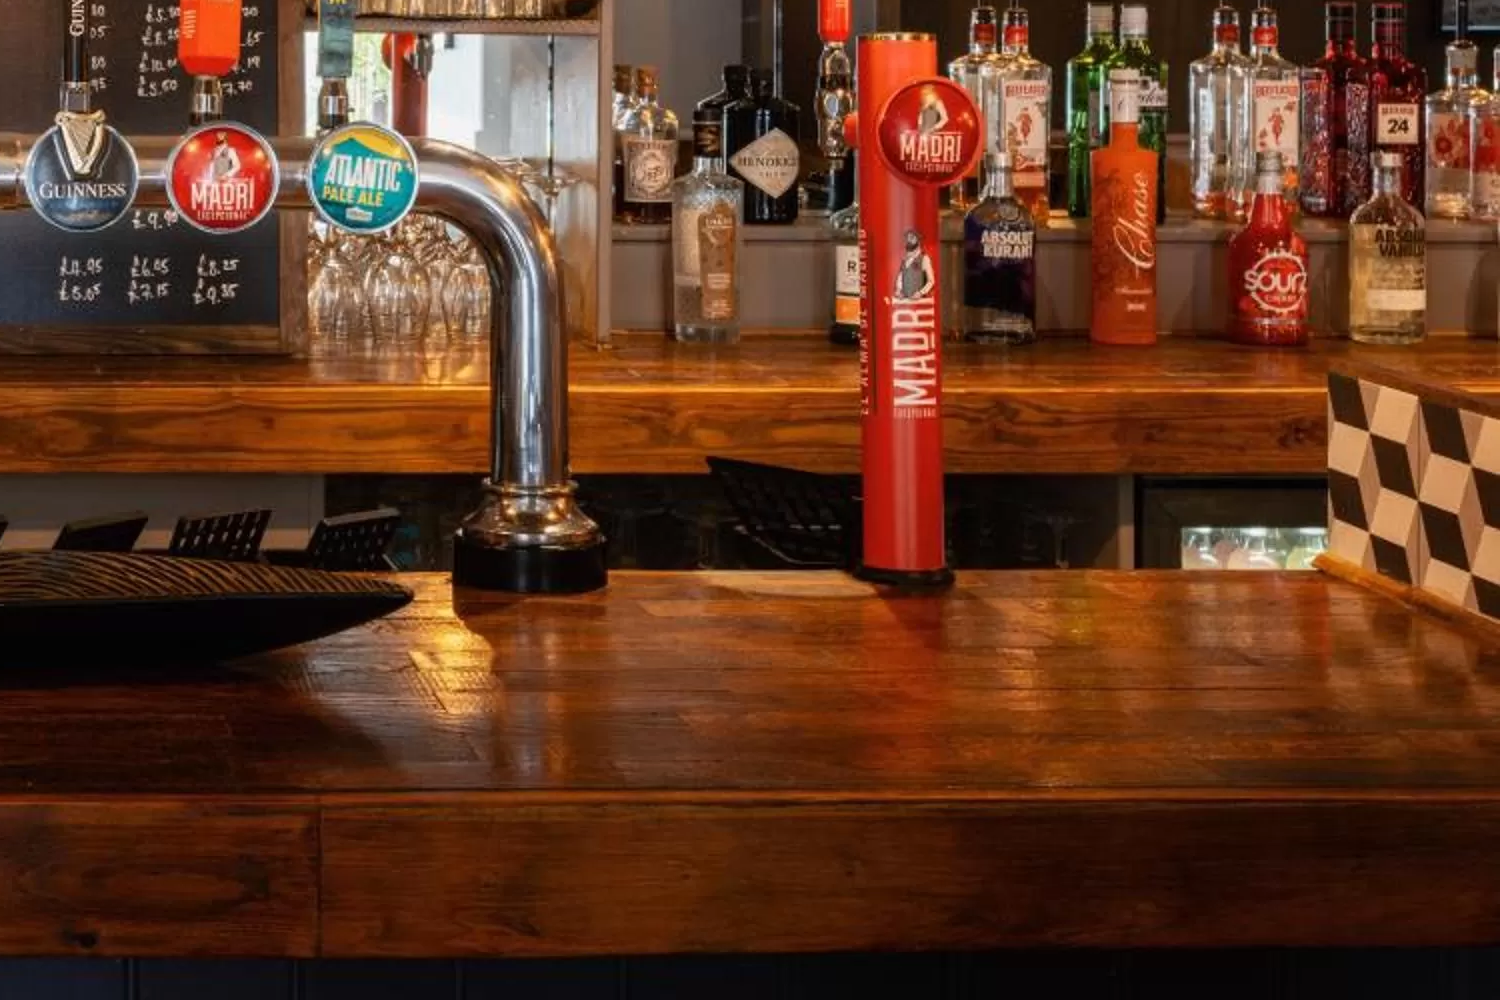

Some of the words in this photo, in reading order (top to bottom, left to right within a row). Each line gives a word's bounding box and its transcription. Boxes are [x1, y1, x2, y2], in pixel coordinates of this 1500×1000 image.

[1388, 118, 1410, 135] 24
[324, 154, 402, 192] ATLANTIC
[39, 181, 127, 198] GUINNESS
[322, 183, 354, 203] PALE
[357, 190, 385, 207] ALE
[981, 231, 1034, 245] ABSOLUT
